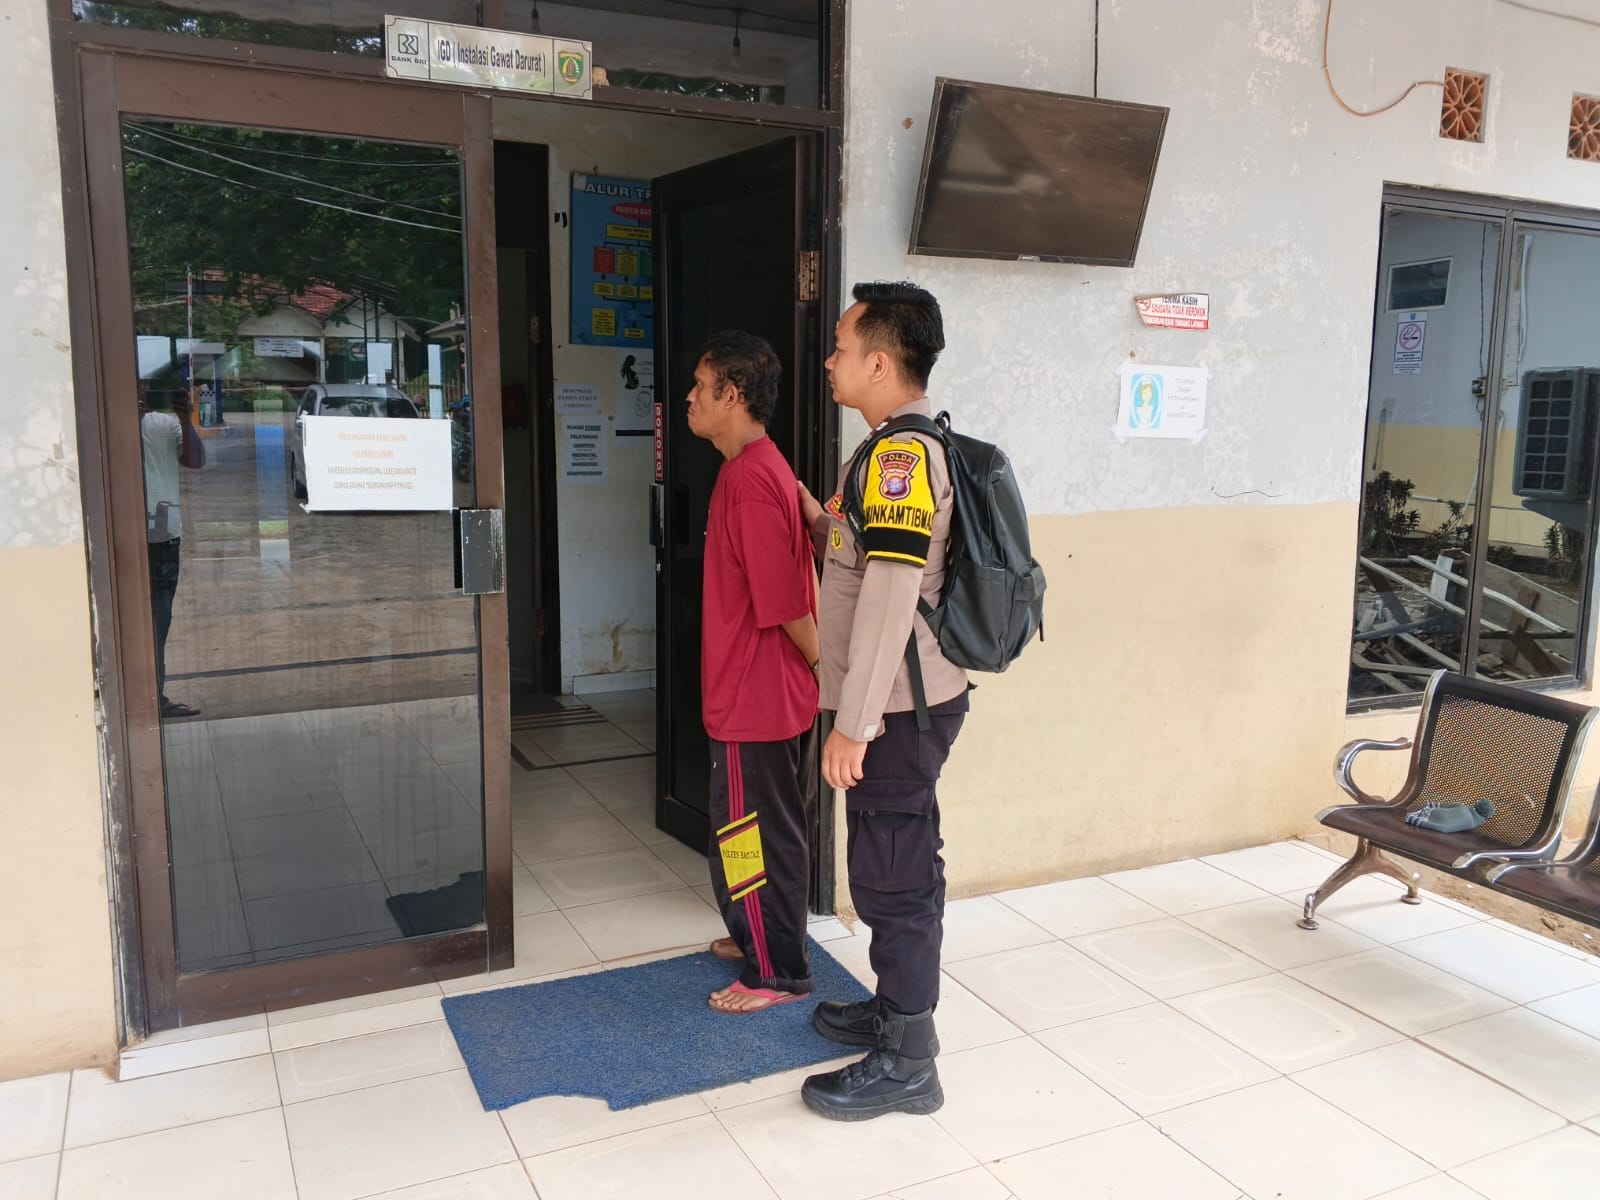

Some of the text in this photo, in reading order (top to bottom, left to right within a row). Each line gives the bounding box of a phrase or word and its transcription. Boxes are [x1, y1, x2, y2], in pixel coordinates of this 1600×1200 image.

[437, 39, 451, 61] IGD
[458, 41, 488, 67] Instalasi
[490, 46, 513, 68] Gawat
[515, 49, 542, 73] Darurat
[585, 183, 629, 197] ALUR
[883, 454, 912, 463] POLDA
